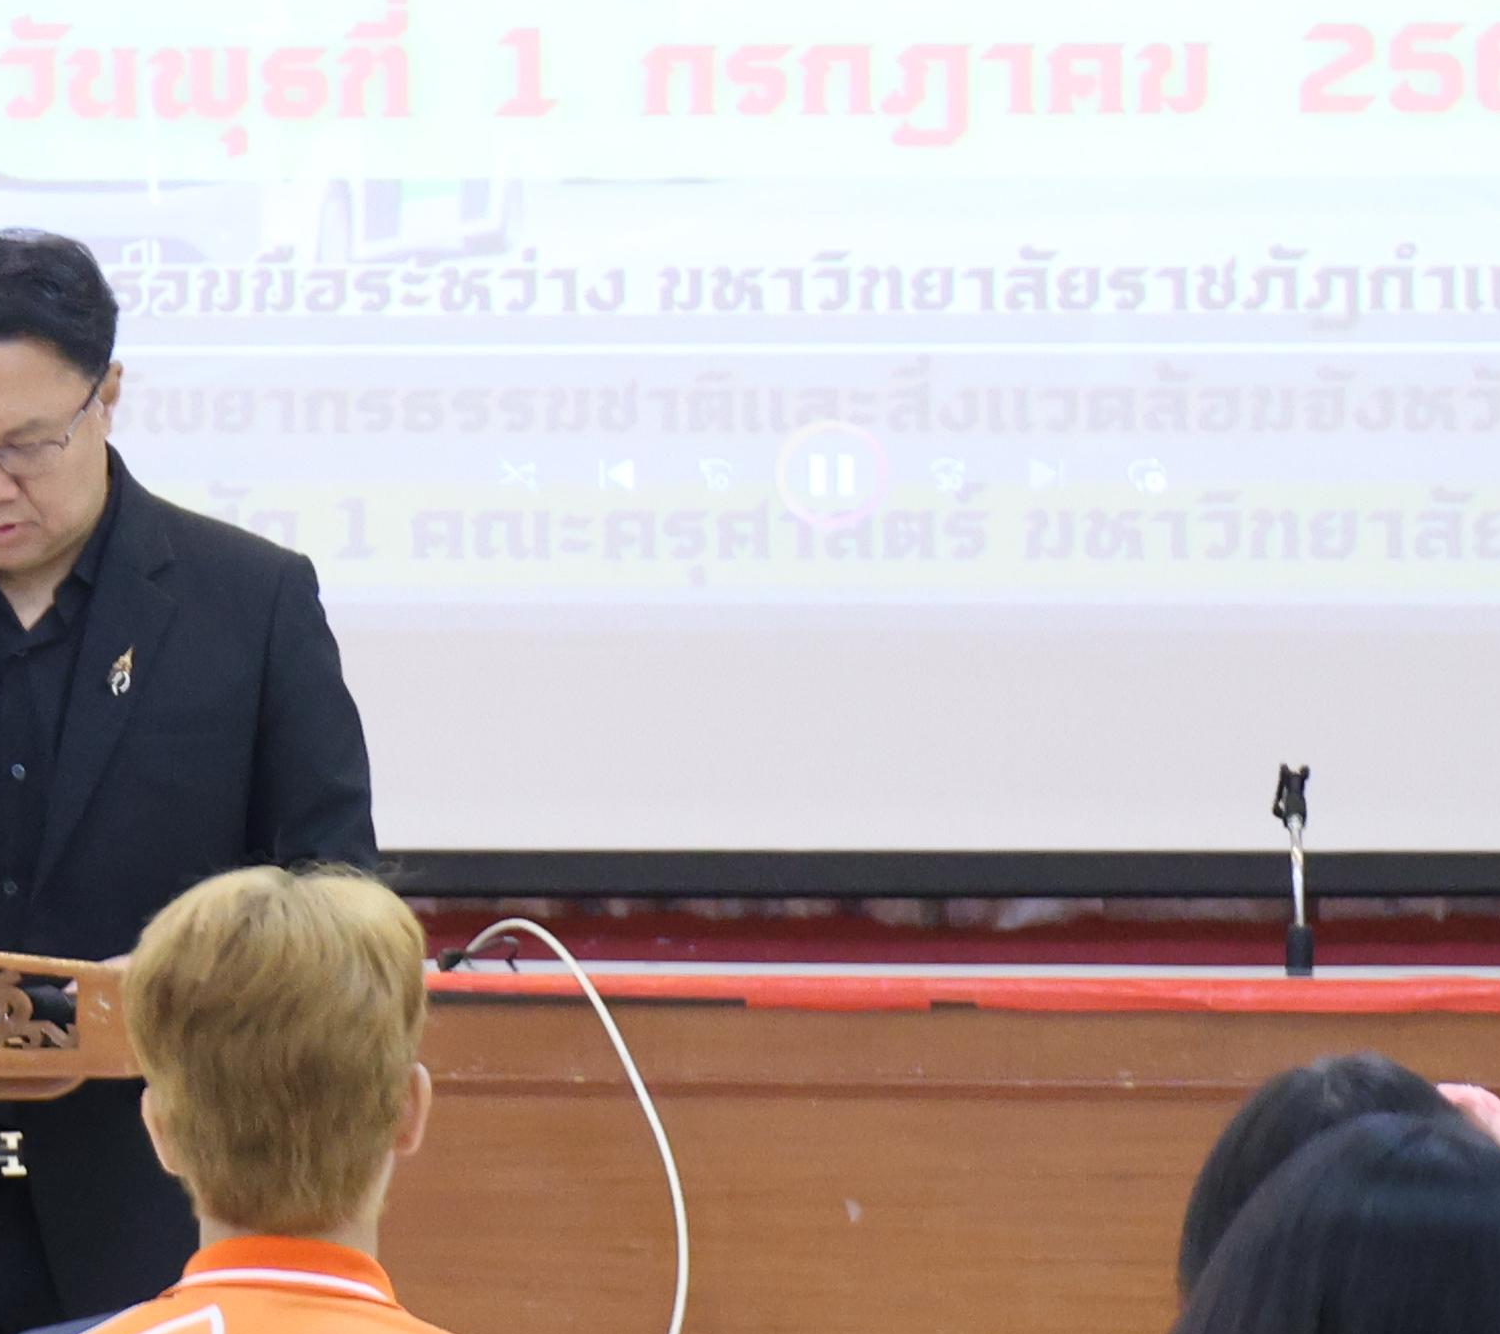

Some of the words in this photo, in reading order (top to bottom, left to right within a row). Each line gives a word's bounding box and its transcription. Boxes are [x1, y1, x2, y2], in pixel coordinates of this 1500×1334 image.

[494, 27, 560, 119] 1
[638, 40, 1212, 148] กรกฎาคม
[409, 481, 991, 587] คณะครุศาสตร์
